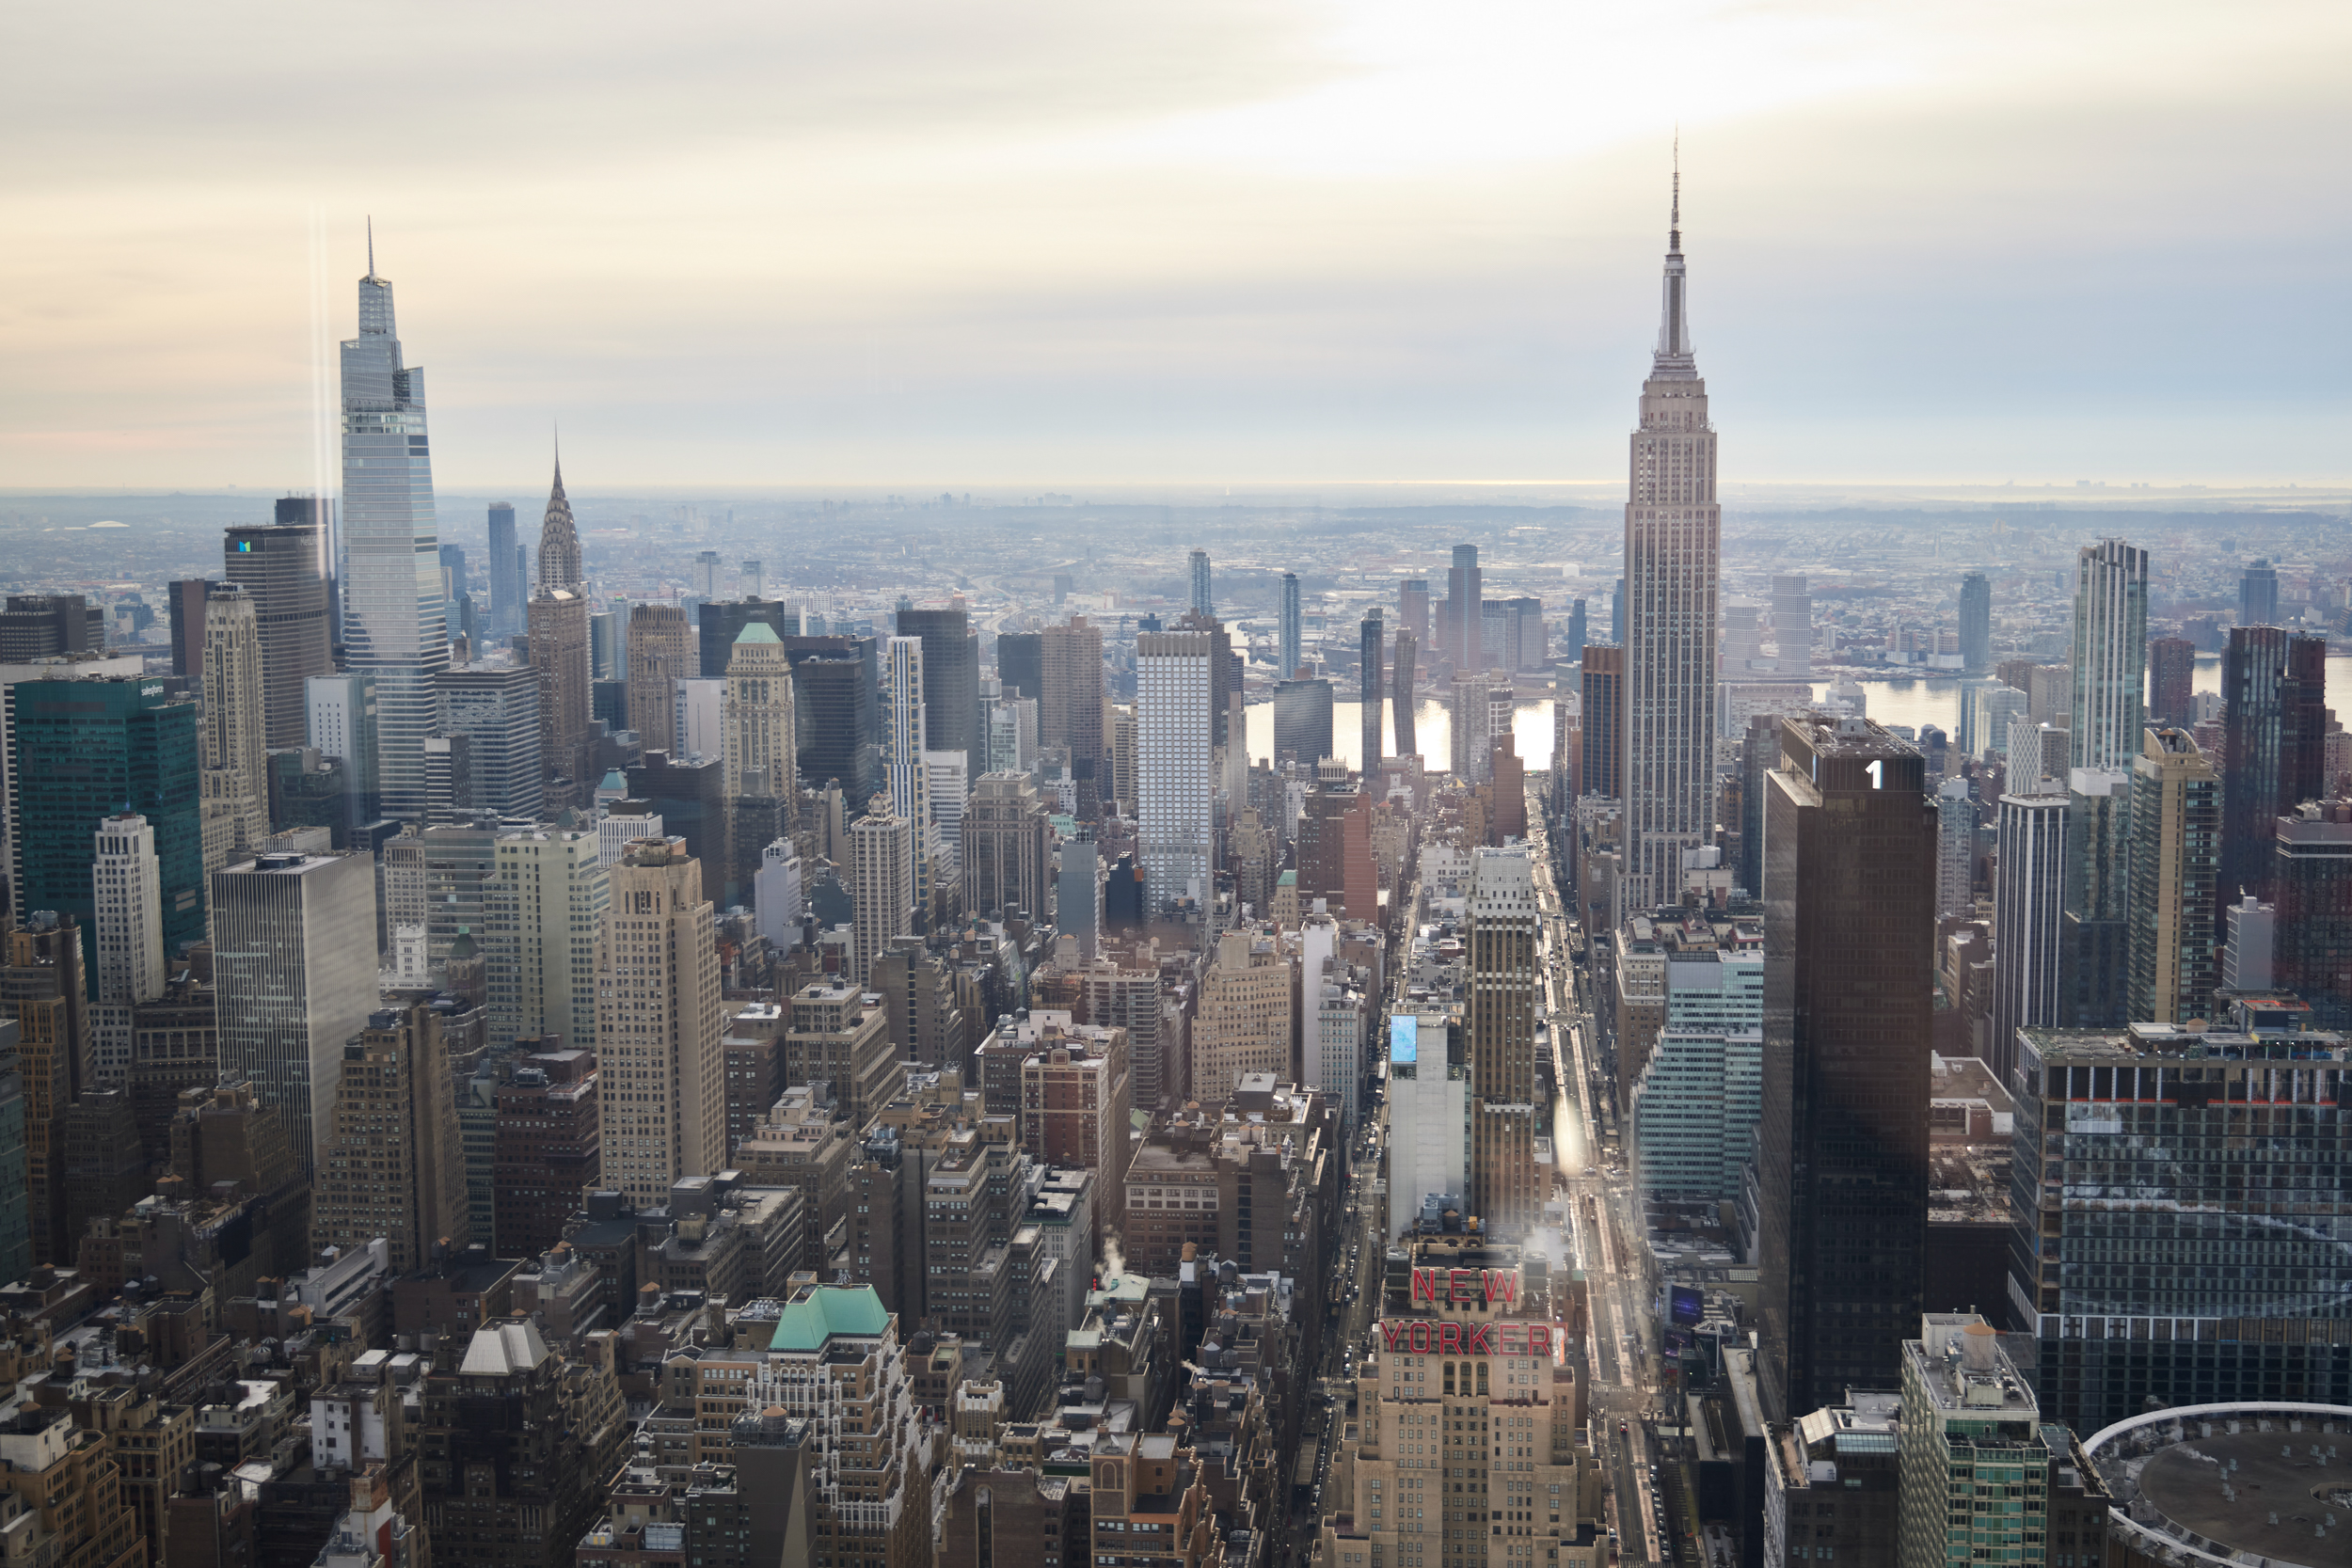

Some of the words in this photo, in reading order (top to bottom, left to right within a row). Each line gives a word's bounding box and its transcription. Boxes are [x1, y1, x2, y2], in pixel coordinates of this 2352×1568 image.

[141, 685, 164, 696] salesforce
[1865, 760, 1883, 789] 1
[1413, 1268, 1518, 1303] NEW
[1379, 1320, 1552, 1356] YORKER
